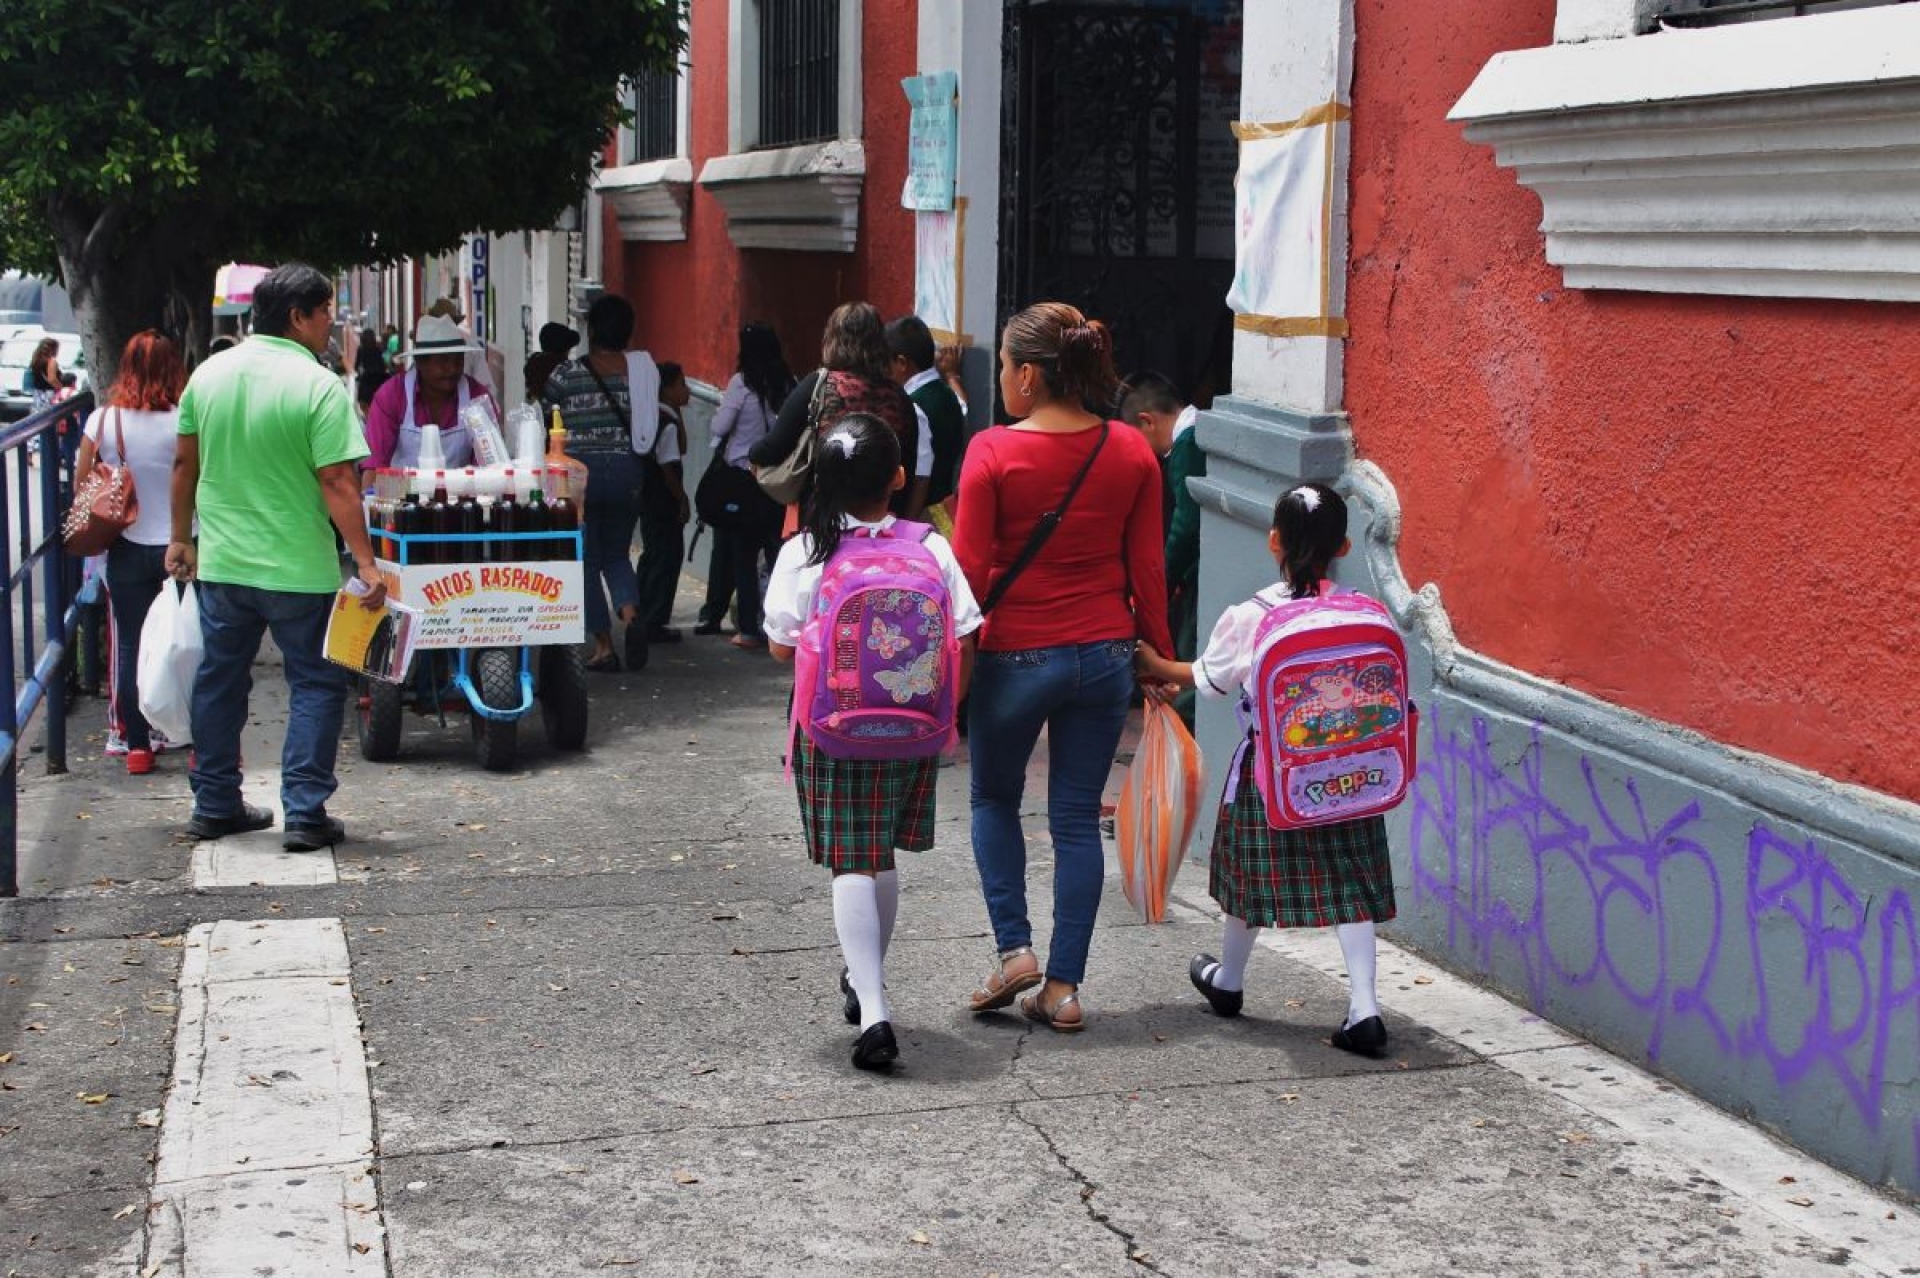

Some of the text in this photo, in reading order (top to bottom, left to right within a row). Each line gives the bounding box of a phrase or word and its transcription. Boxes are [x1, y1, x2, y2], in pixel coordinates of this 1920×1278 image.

[422, 567, 563, 607] RICOS RASPADOS
[458, 634, 522, 644] DIABLITOS
[1305, 768, 1383, 804] Peppa
